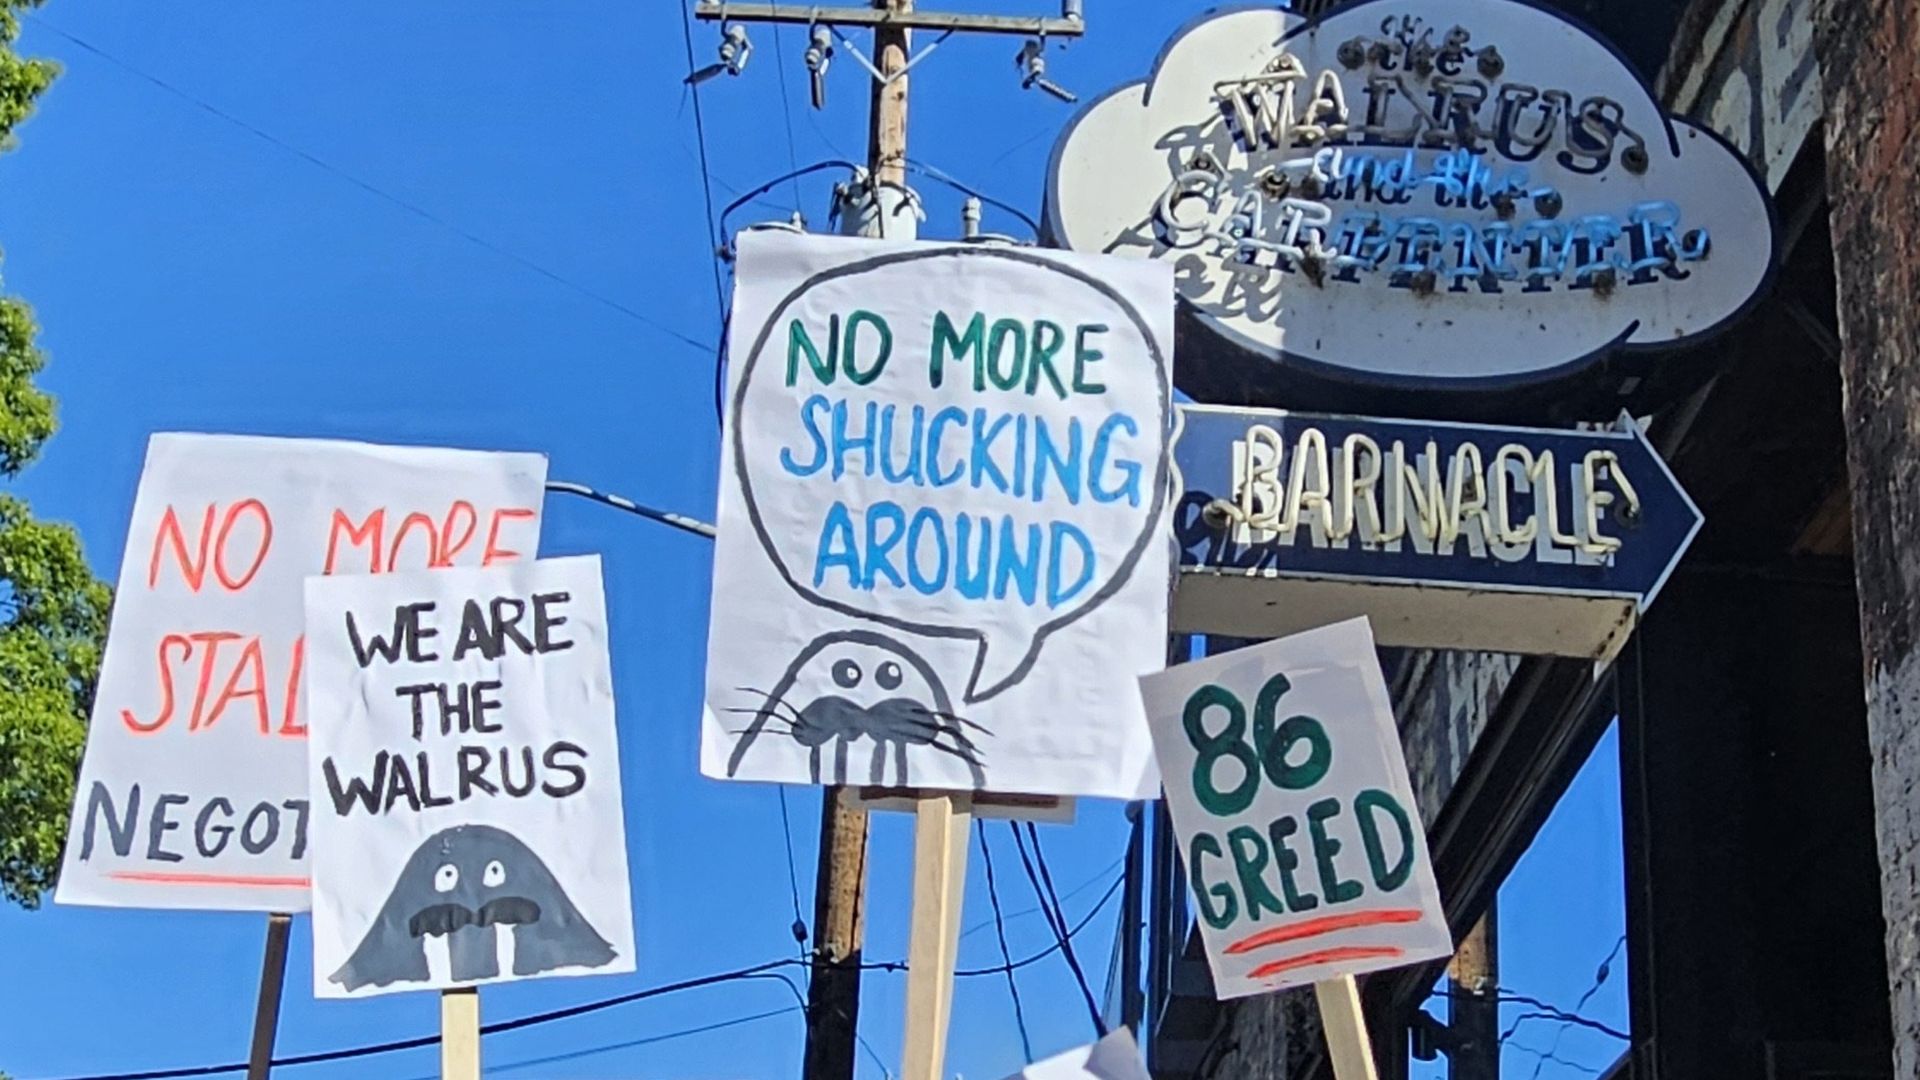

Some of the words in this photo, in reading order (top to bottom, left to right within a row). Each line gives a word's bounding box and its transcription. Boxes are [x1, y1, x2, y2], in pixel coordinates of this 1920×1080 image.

[1381, 14, 1473, 76] the
[1213, 68, 1614, 174] WALRUS
[1430, 147, 1530, 212] the
[1156, 170, 1690, 294] CARPENTER
[785, 310, 893, 387] NO
[930, 311, 1109, 399] MORE
[780, 394, 1141, 507] SHUCKING
[1231, 424, 1623, 568] BARNACLE
[148, 498, 273, 592] NO
[813, 501, 1096, 609] AROUND
[346, 601, 439, 668] WE
[453, 592, 575, 660] ARE
[396, 680, 503, 740] THE
[1182, 672, 1332, 817] 86
[321, 740, 589, 817] WALRUS
[1190, 789, 1416, 930] GREED
